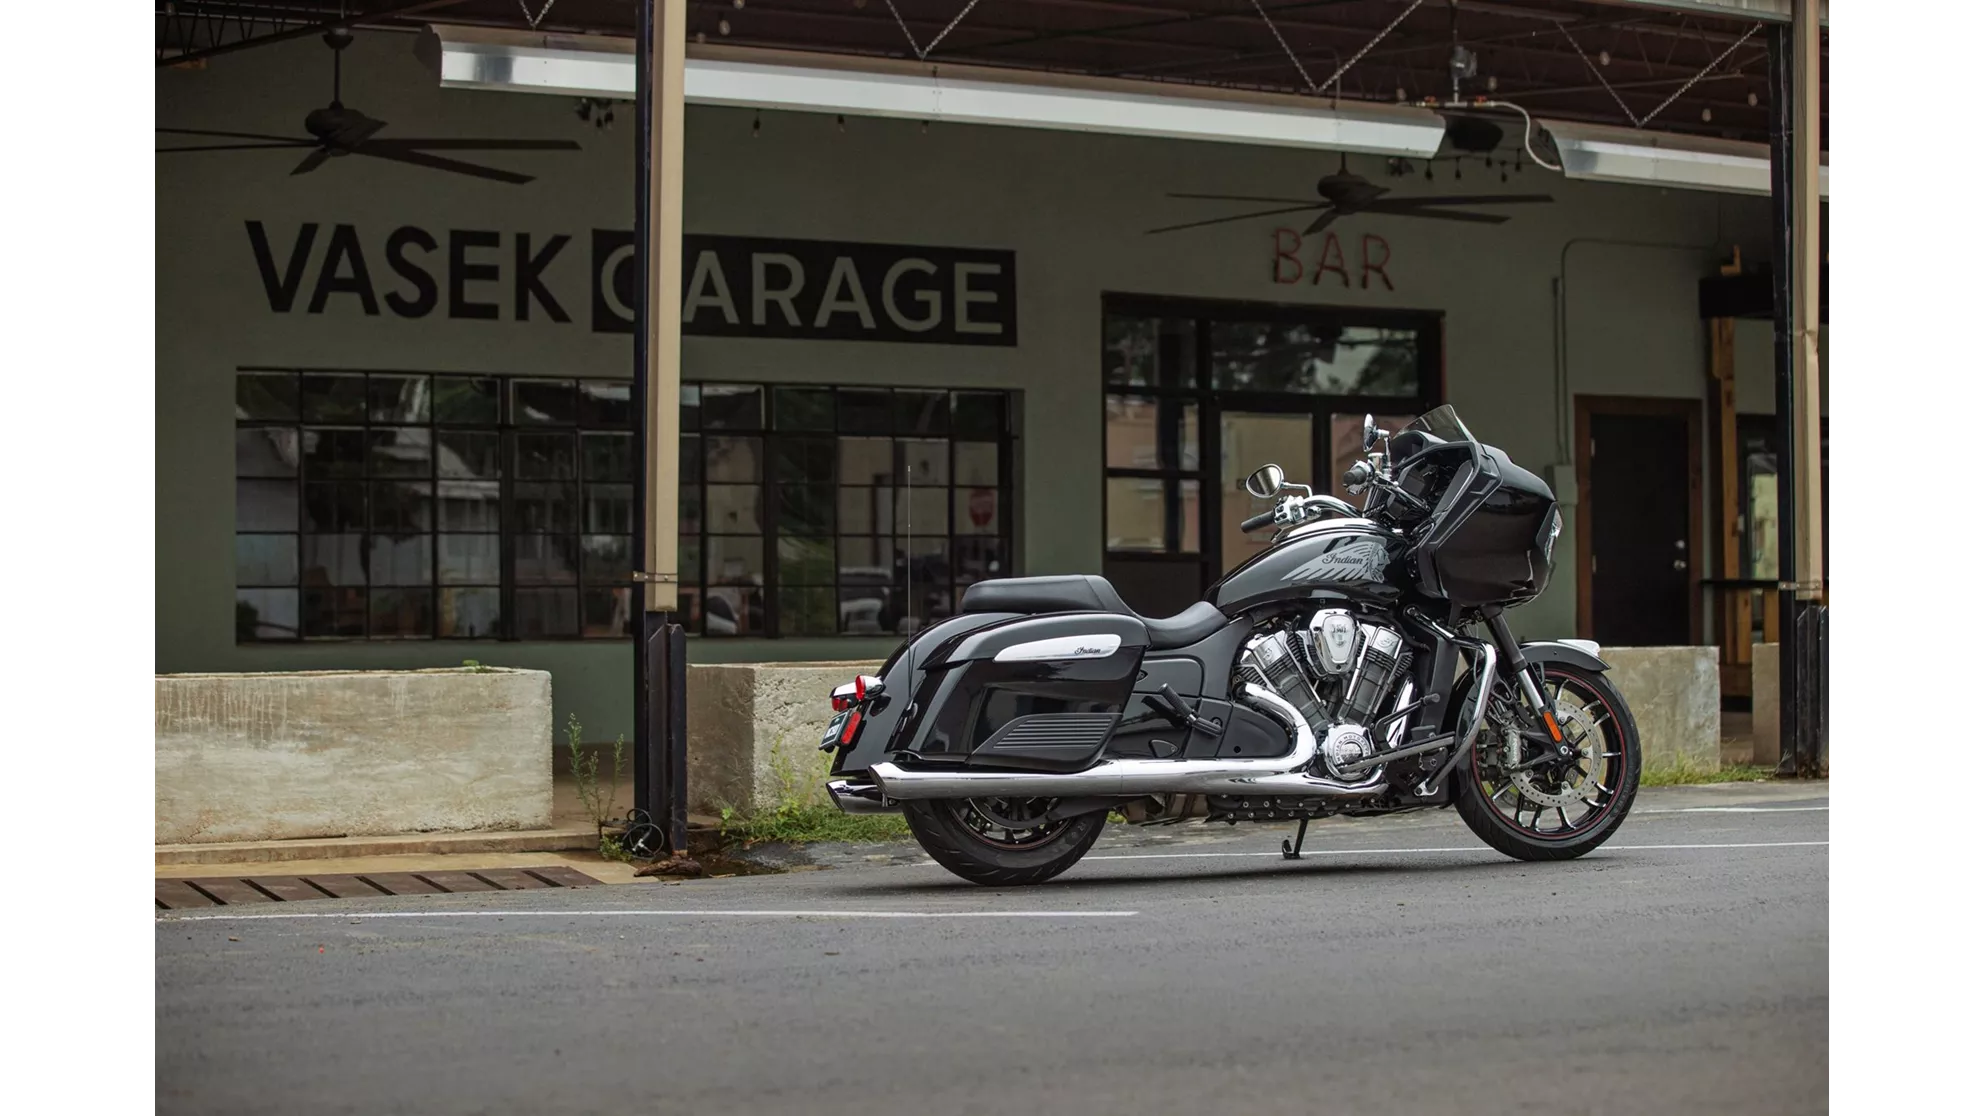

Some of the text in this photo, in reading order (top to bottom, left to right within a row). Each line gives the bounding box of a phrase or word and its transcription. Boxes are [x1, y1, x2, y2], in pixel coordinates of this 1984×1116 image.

[244, 220, 573, 323] VASEK
[1273, 227, 1394, 291] BAR
[1322, 553, 1363, 564] Indian
[1074, 646, 1101, 655] Indian
